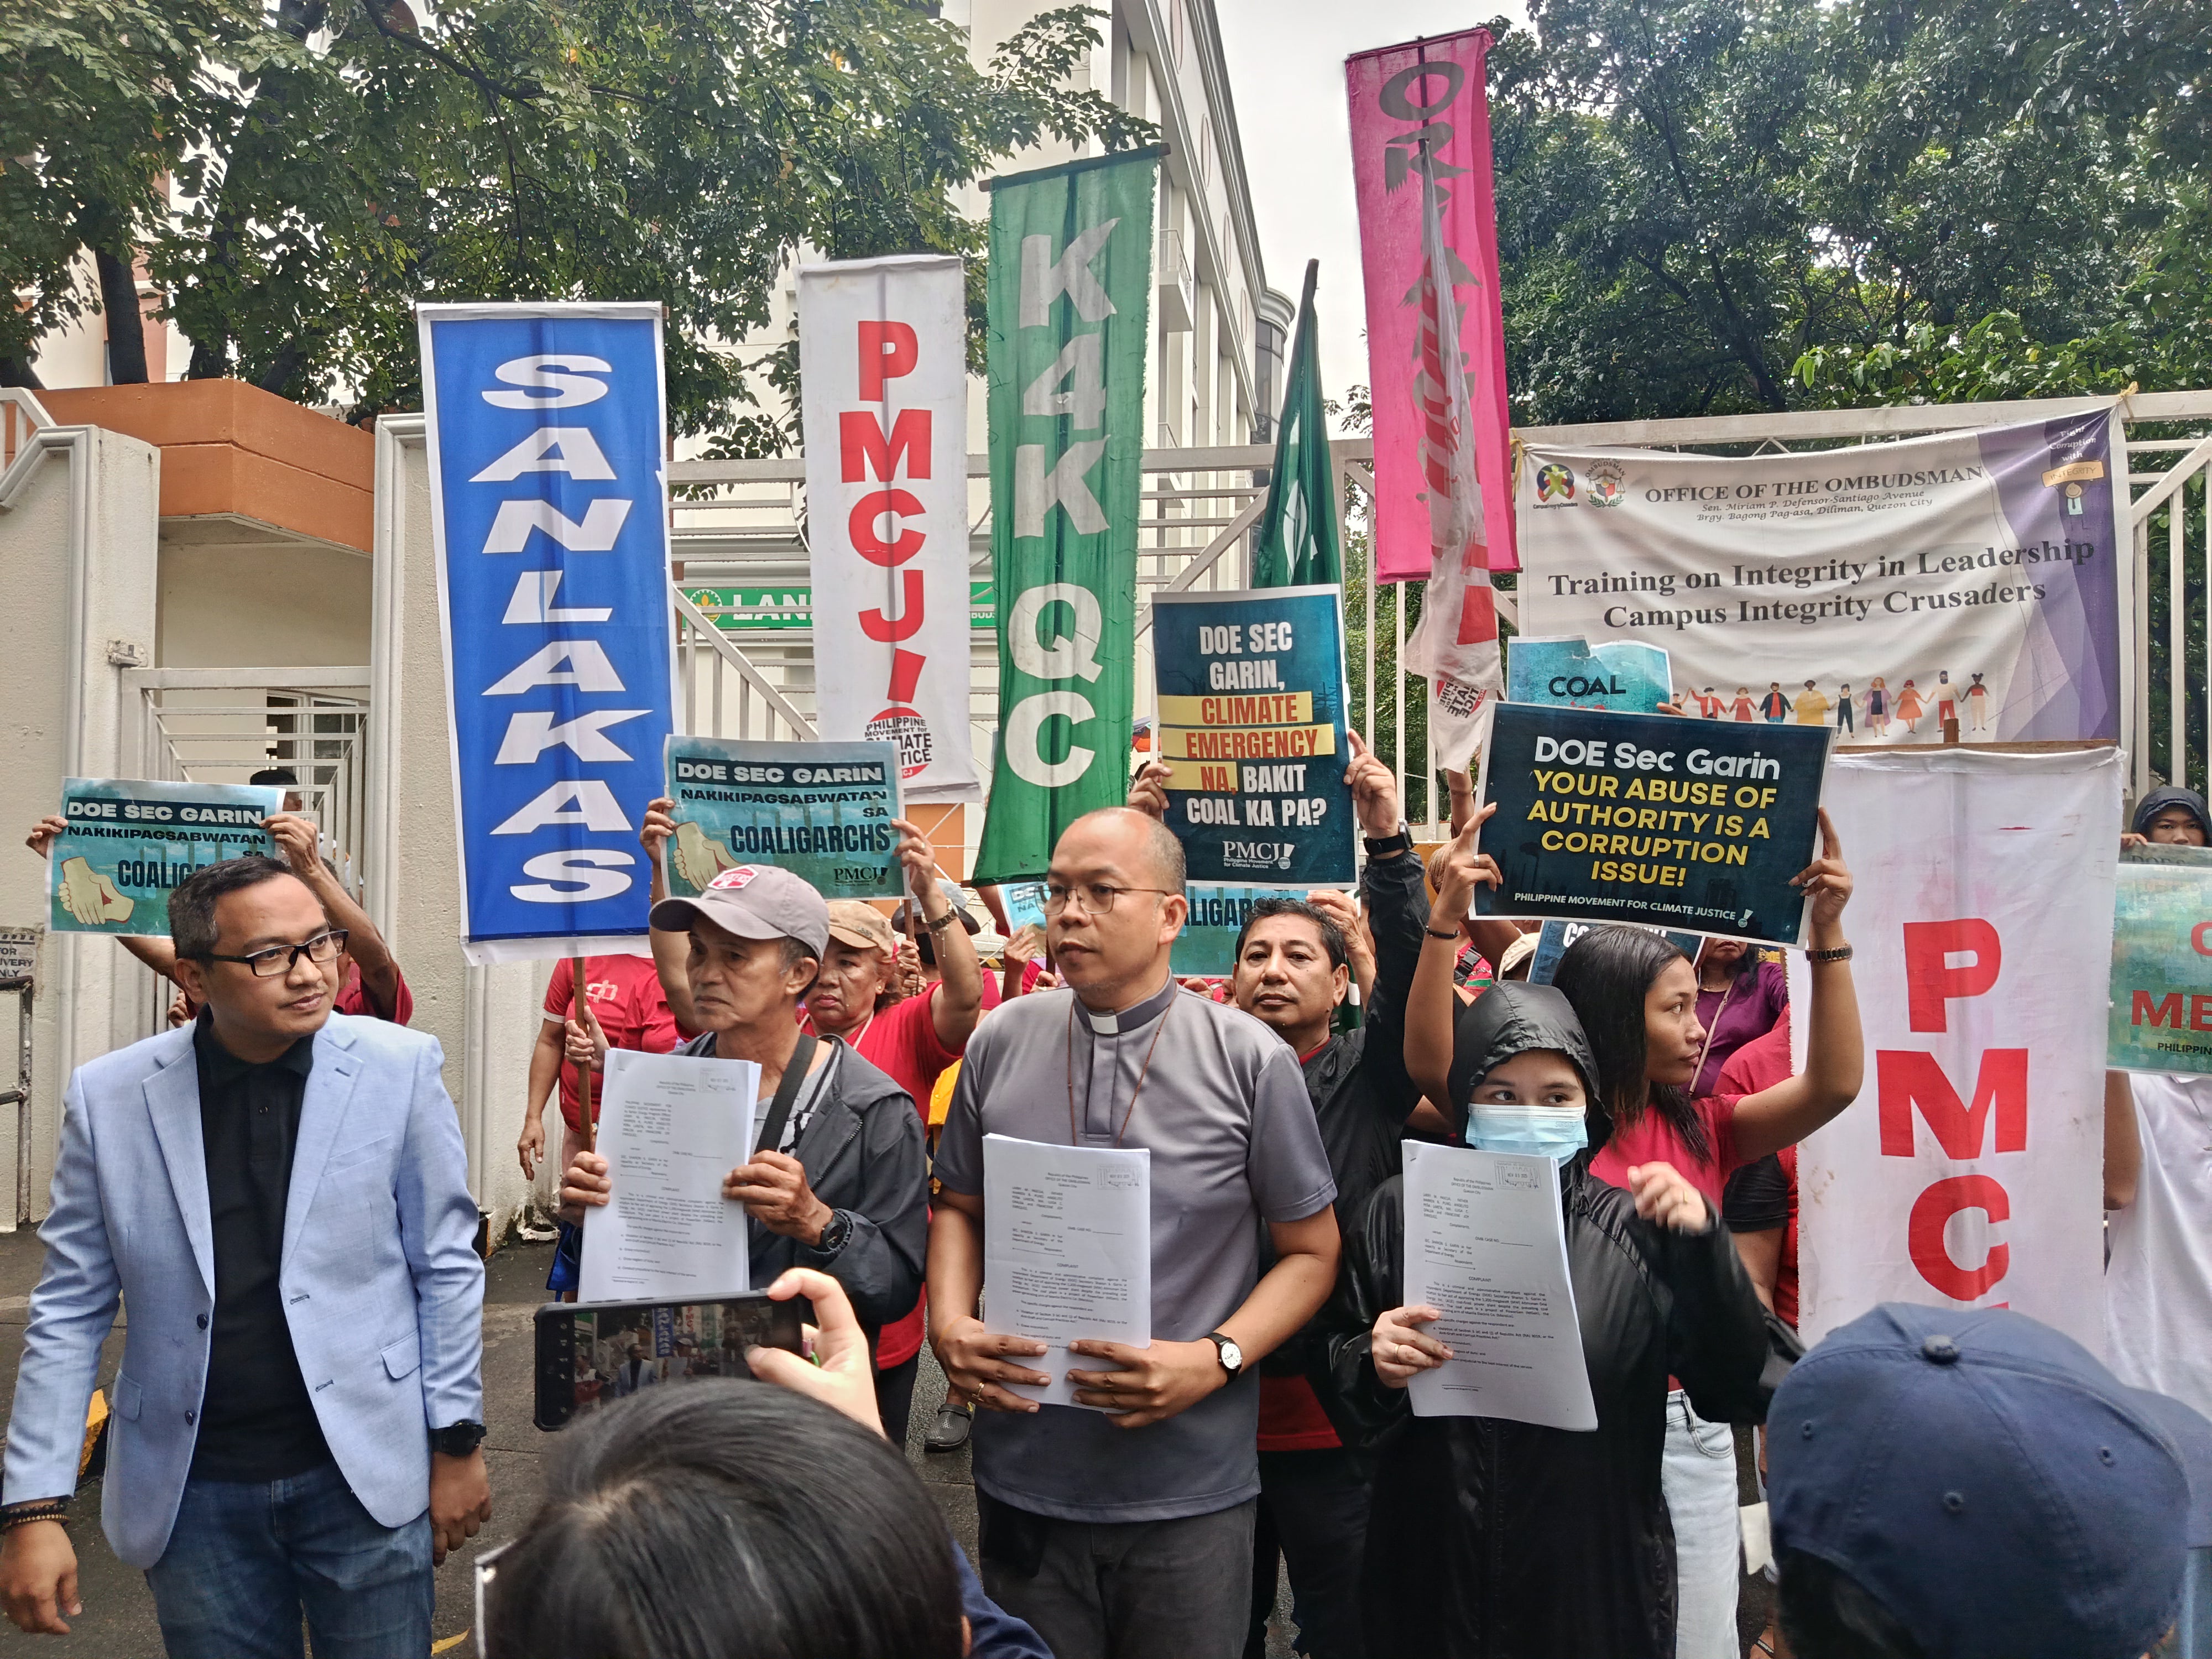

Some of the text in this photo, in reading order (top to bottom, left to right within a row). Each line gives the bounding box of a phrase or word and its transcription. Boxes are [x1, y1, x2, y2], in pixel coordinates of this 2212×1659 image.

[2049, 437, 2096, 450] Corruption
[2062, 451, 2083, 461] with
[1585, 461, 1626, 478] OMBUDSMAN
[2051, 467, 2095, 480] INTEGRITY
[1645, 466, 1983, 503] OFFICE OF THE OMBUDSMAN
[1697, 498, 1933, 523] Brgy. Bagong Pag-asa, Diliman, Quezon City
[1783, 494, 1880, 509] Defensor-Santiago
[1885, 491, 1925, 500] Avenue
[1548, 538, 2095, 596] Training on Integrity in Leadership
[733, 594, 812, 620] LAN
[1604, 582, 2046, 630] Campus Integrity Crusaders
[468, 354, 654, 902] SANLAKAS
[1199, 622, 1292, 655] DOE SEC
[1005, 583, 1103, 787] QC
[1209, 659, 1285, 691] GARIN,
[1549, 675, 1626, 697] COAL
[1201, 695, 1298, 724] CLIMATE
[865, 727, 915, 737] MOVEMENT
[867, 717, 926, 732] PHILIPPINE
[1186, 729, 1318, 759] EMERGENCY
[1534, 736, 1780, 780] DOE Sec Garin
[677, 763, 883, 783] DOE SEC GARIN
[1200, 764, 1306, 795] NA, BAKIT
[681, 789, 887, 805] NAKIKIPAGSABWATAN
[1533, 769, 1777, 810] YOUR ABUSE OF
[67, 802, 263, 825] DOE SEC GARIN
[863, 807, 889, 818] SA
[1186, 797, 1327, 826] COAL KA PA?
[1527, 799, 1771, 839] AUTHORITY IS A
[67, 826, 266, 844] NAKIKIPAGSABWATAN
[731, 824, 890, 854] COALIGARCHS
[1541, 830, 1749, 866] CORRUPTION
[1590, 860, 1687, 888] ISSUE!
[1514, 893, 1736, 920] PHILIPPINE MOVEMENT FOR CLIMATE JUSTICE
[2157, 1042, 2212, 1055] PHILIPPIN
[1876, 918, 2028, 1309] PMC
